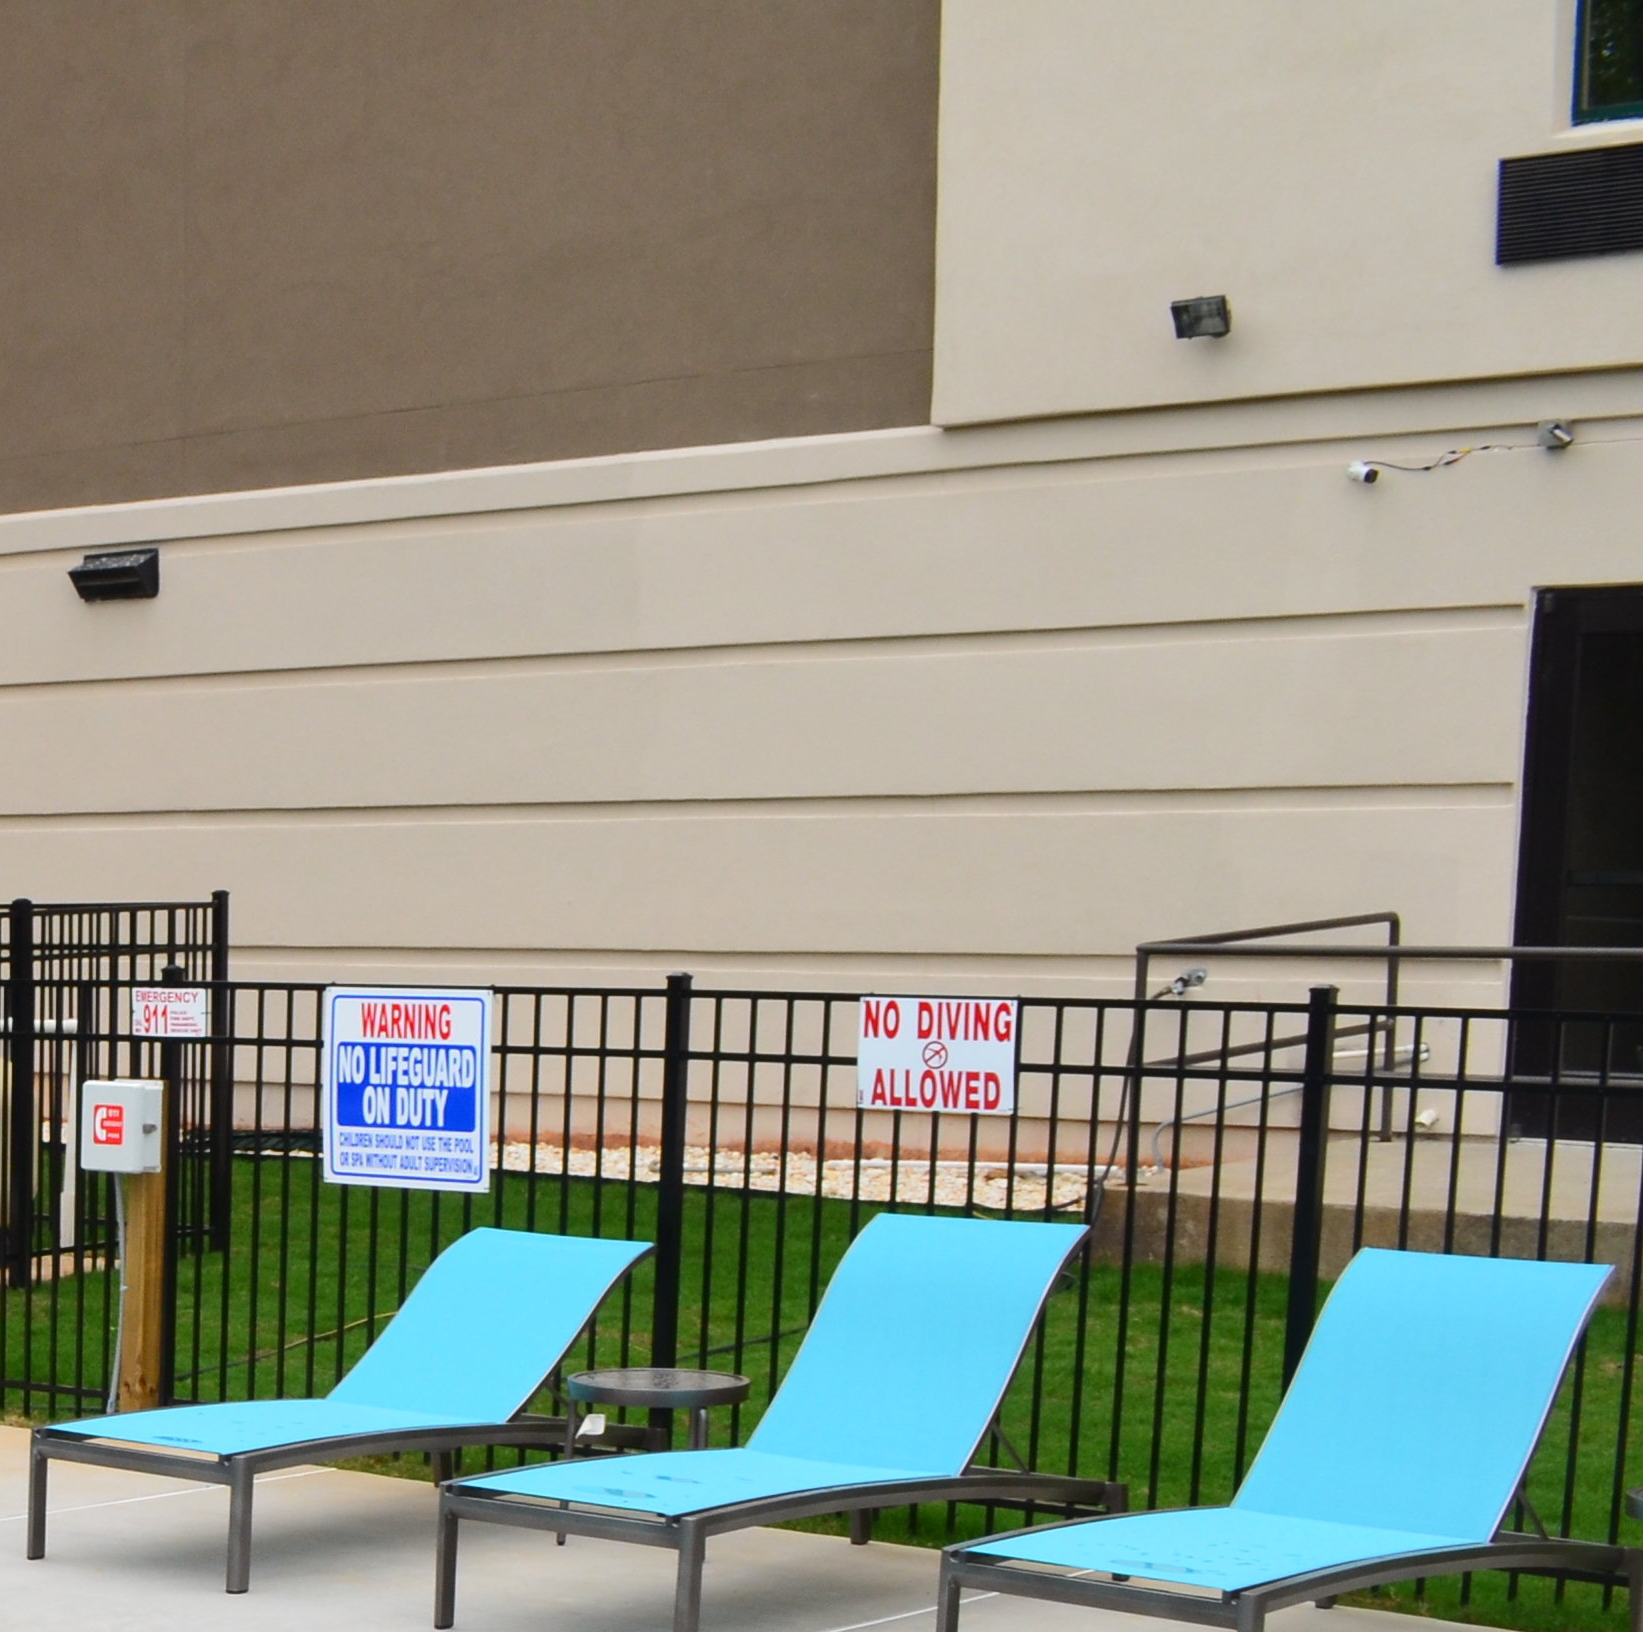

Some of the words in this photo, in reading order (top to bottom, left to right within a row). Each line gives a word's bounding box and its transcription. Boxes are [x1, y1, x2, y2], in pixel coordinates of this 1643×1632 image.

[136, 990, 198, 1004] EMERGENCY
[143, 1004, 168, 1034] 911
[361, 1003, 452, 1040] WARNING
[864, 1000, 901, 1039] NO
[917, 1001, 1012, 1042] DIVING
[339, 1045, 365, 1085] NO
[369, 1046, 476, 1089] LIFEGUARD
[363, 1086, 390, 1125] ON
[396, 1088, 448, 1128] DUTY
[871, 1069, 1001, 1110] ALLOWED
[438, 1137, 452, 1152] THE
